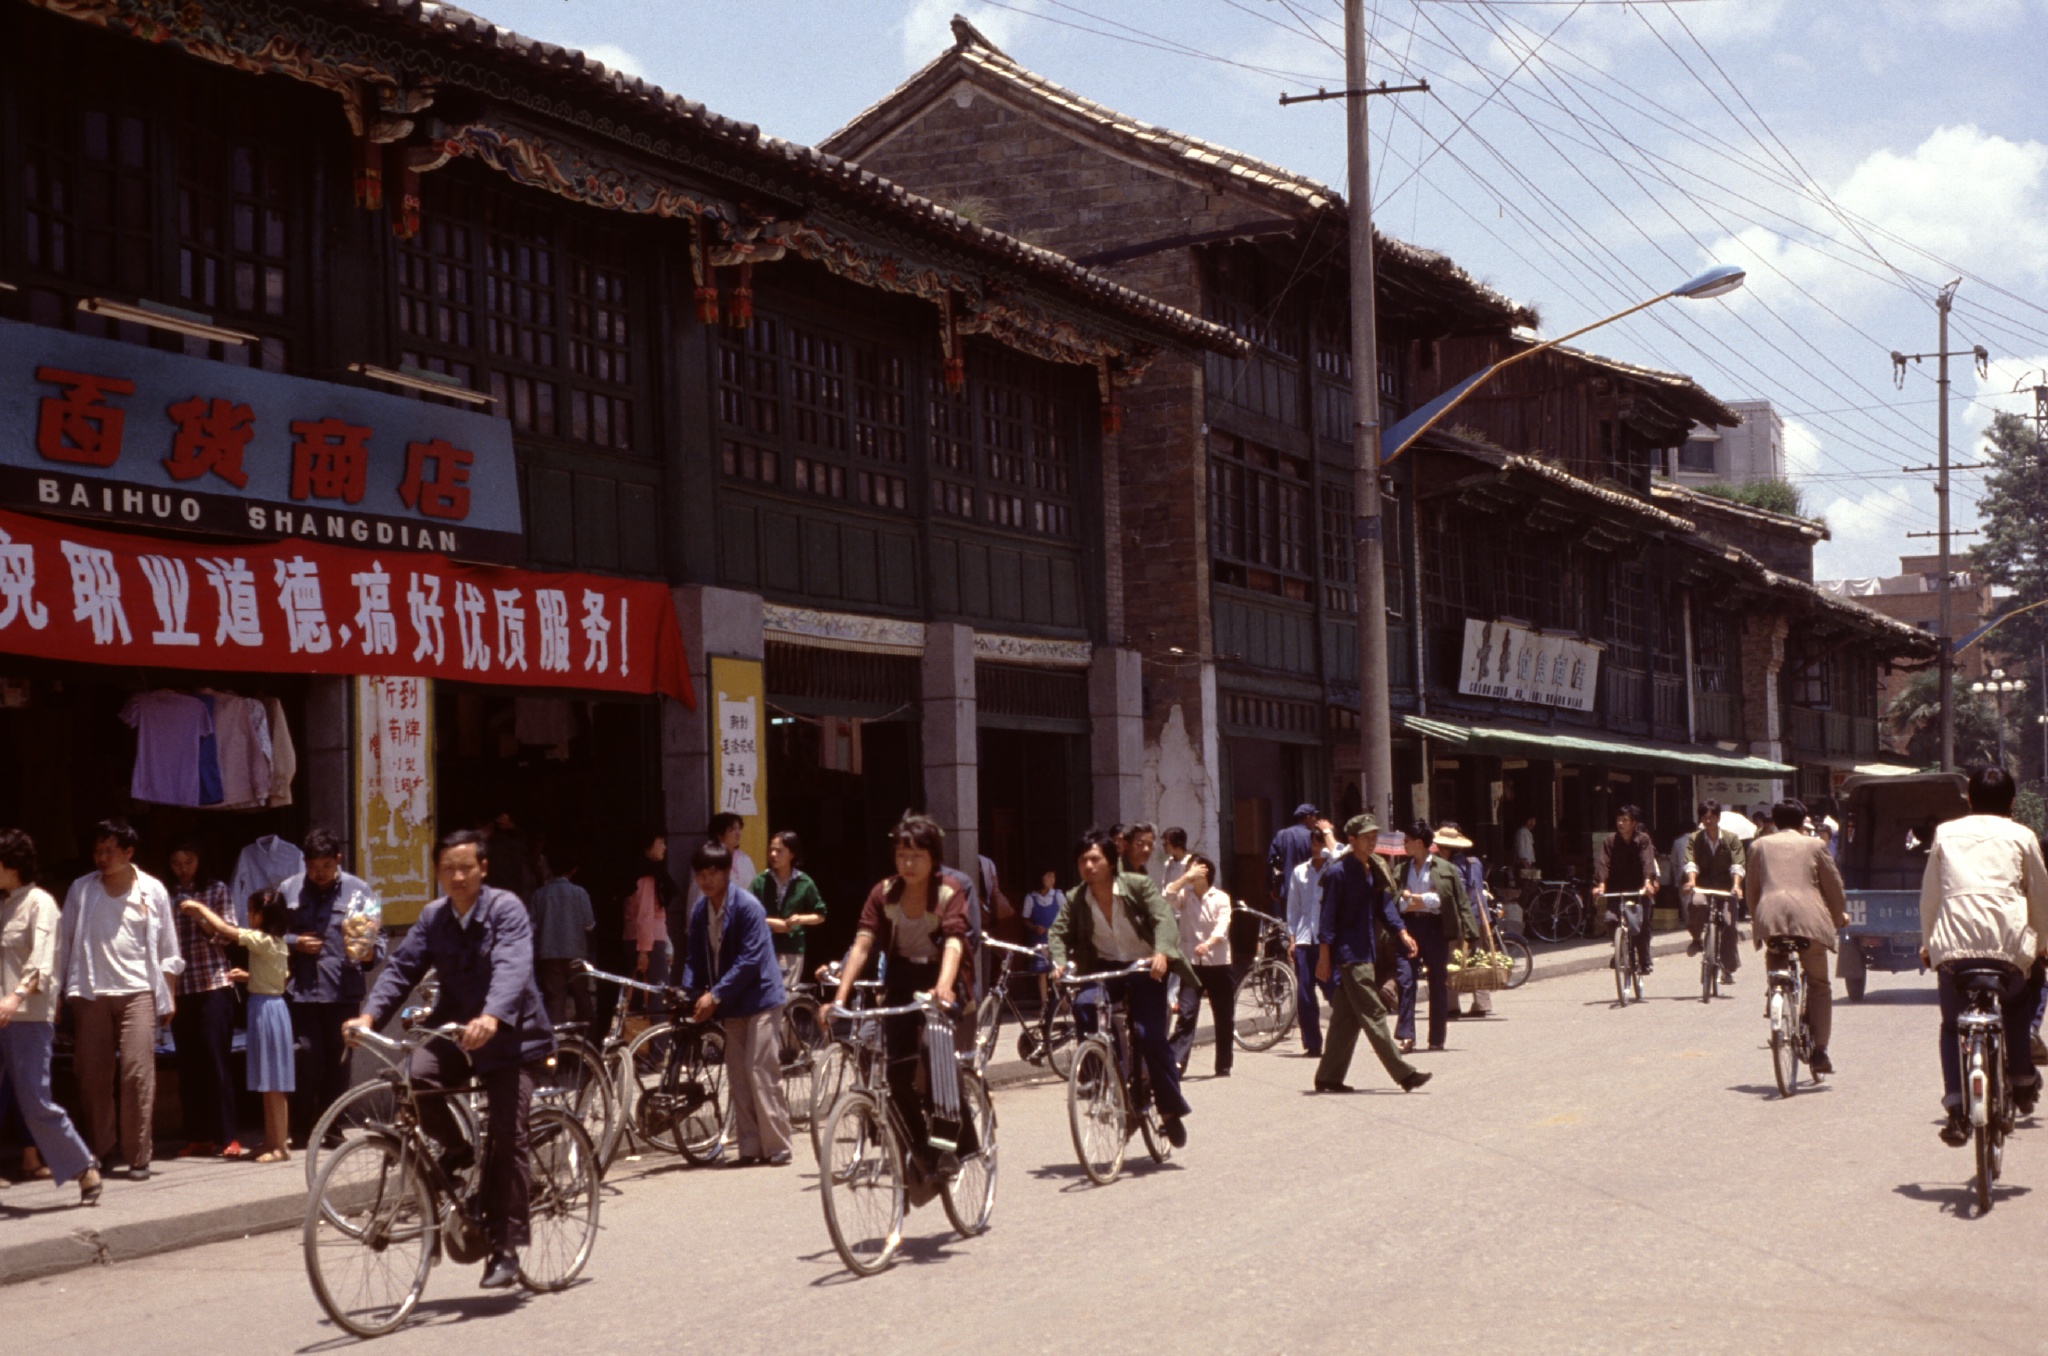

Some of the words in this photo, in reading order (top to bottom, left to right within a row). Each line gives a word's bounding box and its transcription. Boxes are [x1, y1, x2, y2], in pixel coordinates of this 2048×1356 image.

[36, 366, 474, 520] 百货商店
[38, 479, 201, 522] BAIHUO
[248, 506, 457, 552] SHANGDIAN
